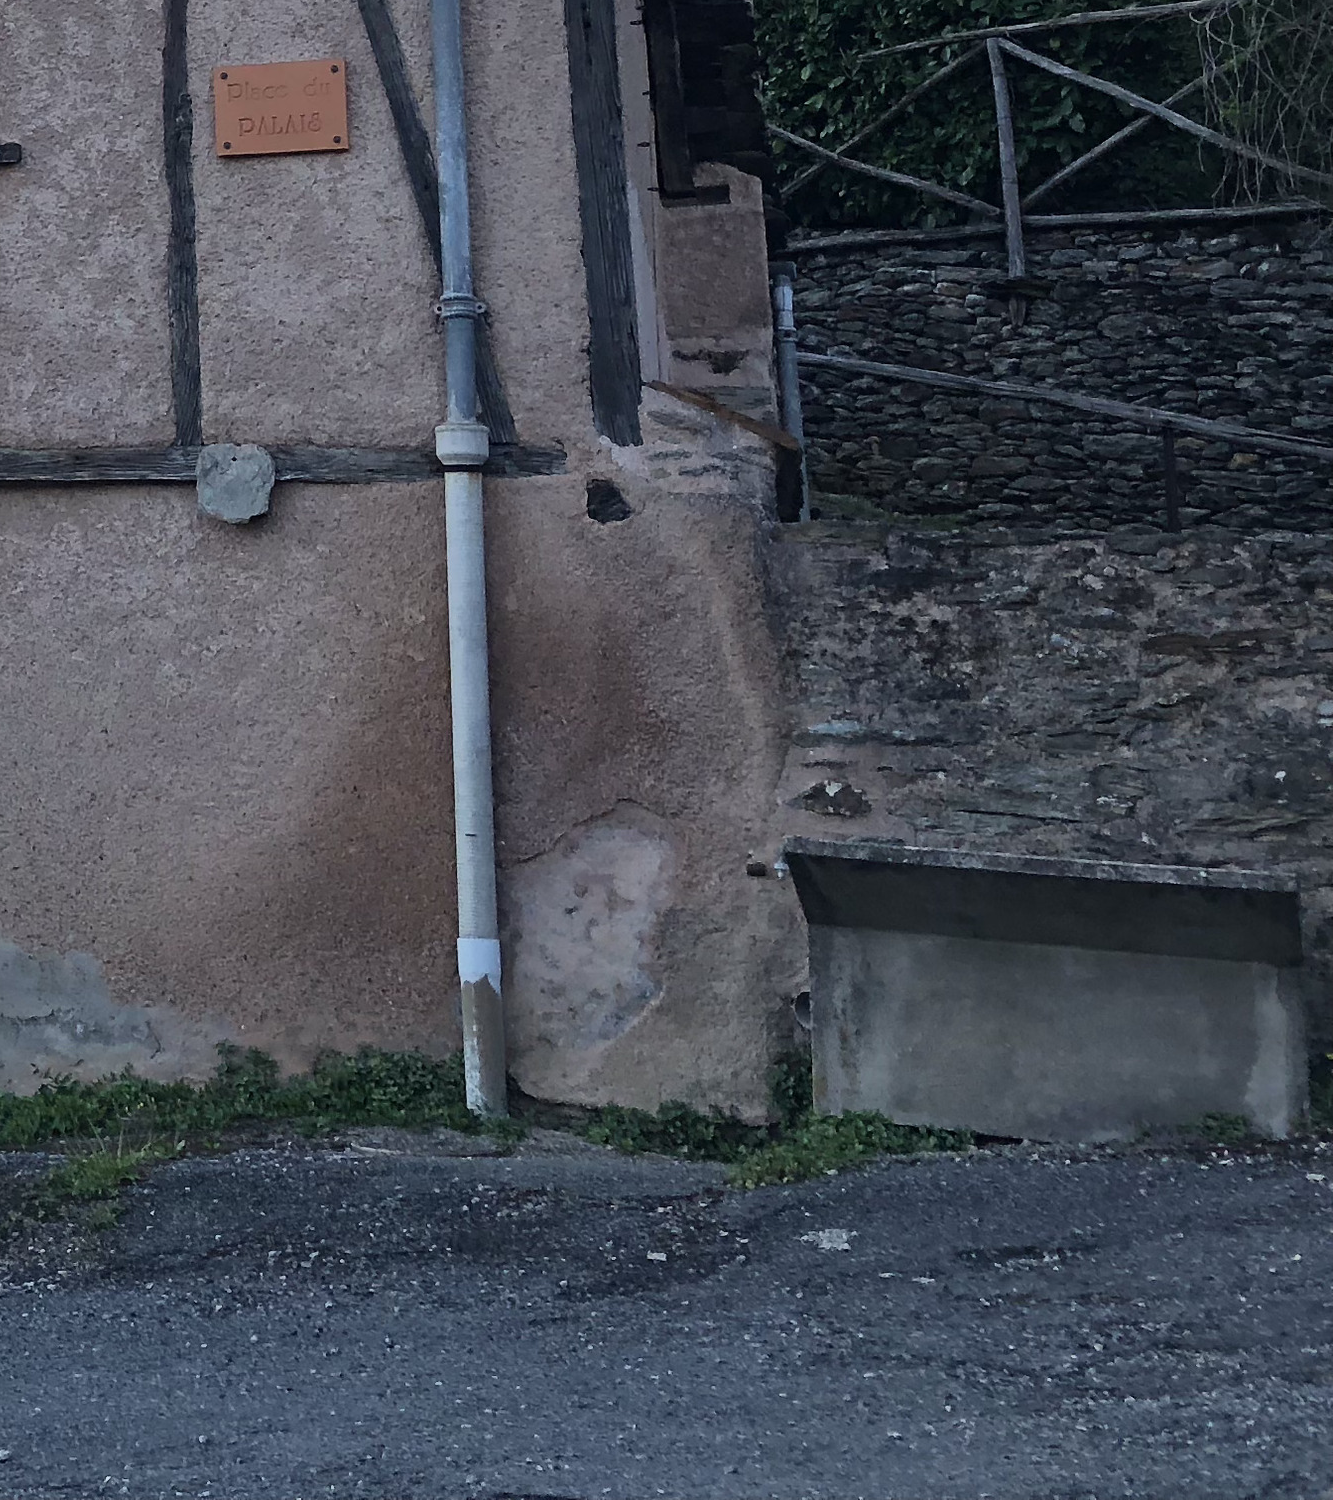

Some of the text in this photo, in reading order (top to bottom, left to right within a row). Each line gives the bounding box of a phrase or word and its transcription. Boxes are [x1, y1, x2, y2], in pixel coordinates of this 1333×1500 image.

[227, 76, 331, 102] Place du
[238, 111, 322, 137] PALAIS
